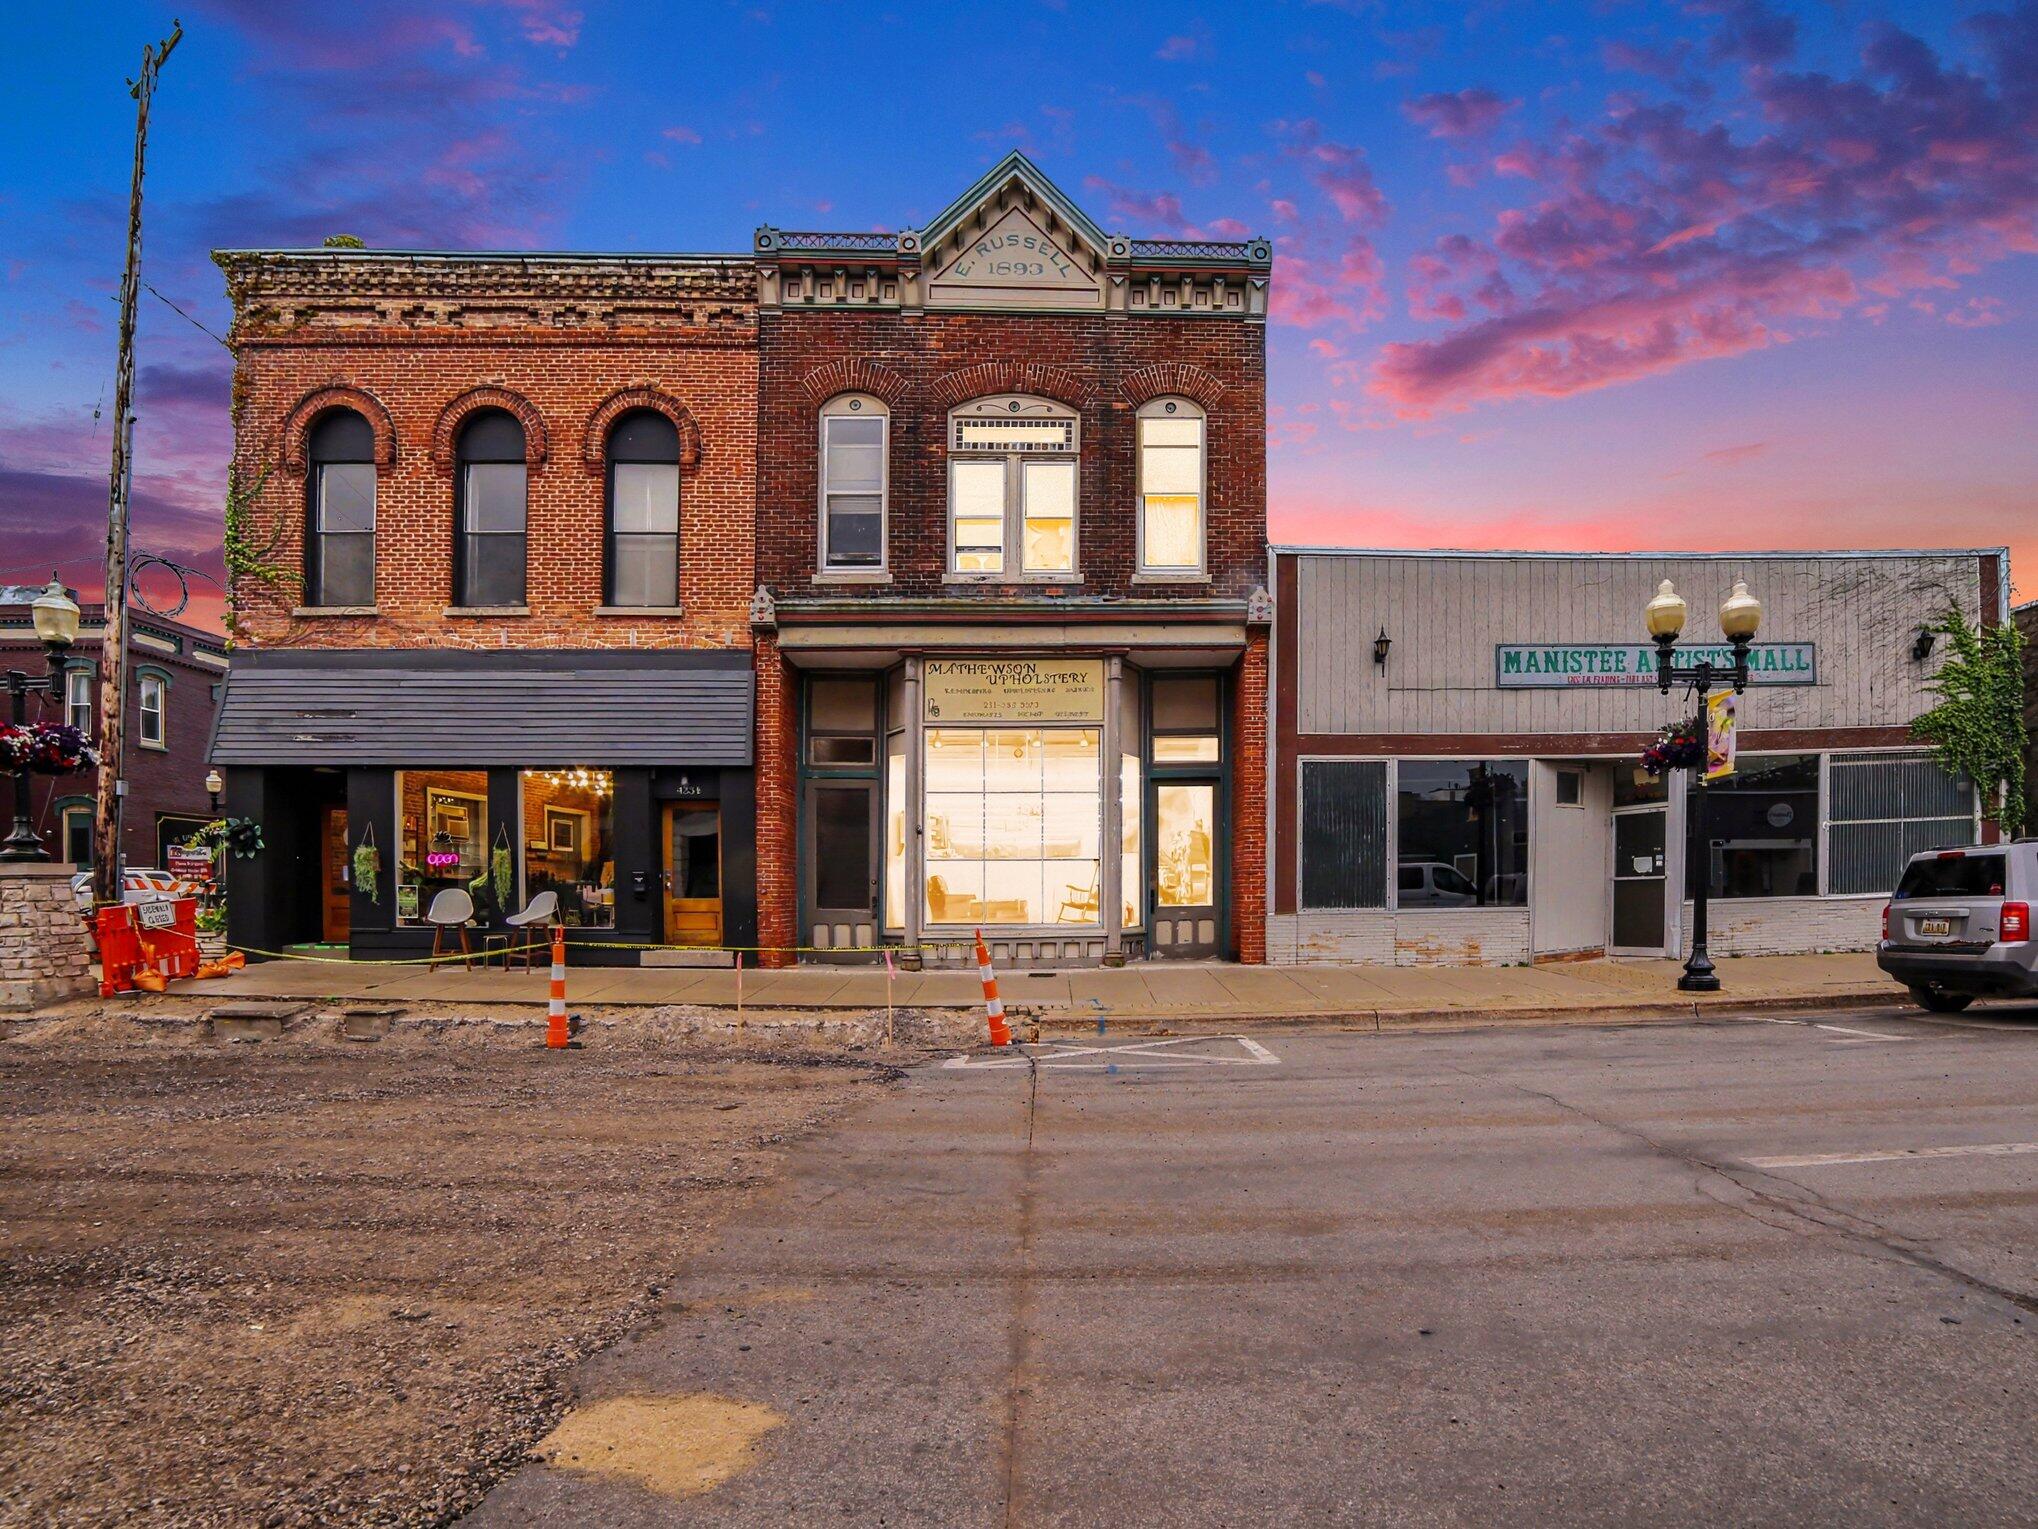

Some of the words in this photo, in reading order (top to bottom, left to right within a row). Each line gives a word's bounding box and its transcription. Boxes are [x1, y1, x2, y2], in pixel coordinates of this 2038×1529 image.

[975, 234, 1071, 278] RUSSELL
[987, 261, 1044, 276] 1893
[1503, 650, 1627, 673] MANISTEE
[1636, 648, 1736, 672] ATIST'S
[1746, 648, 1810, 671] MALL
[928, 663, 1037, 675] MATHEWSON
[986, 672, 1088, 685] UPHOLSTERY
